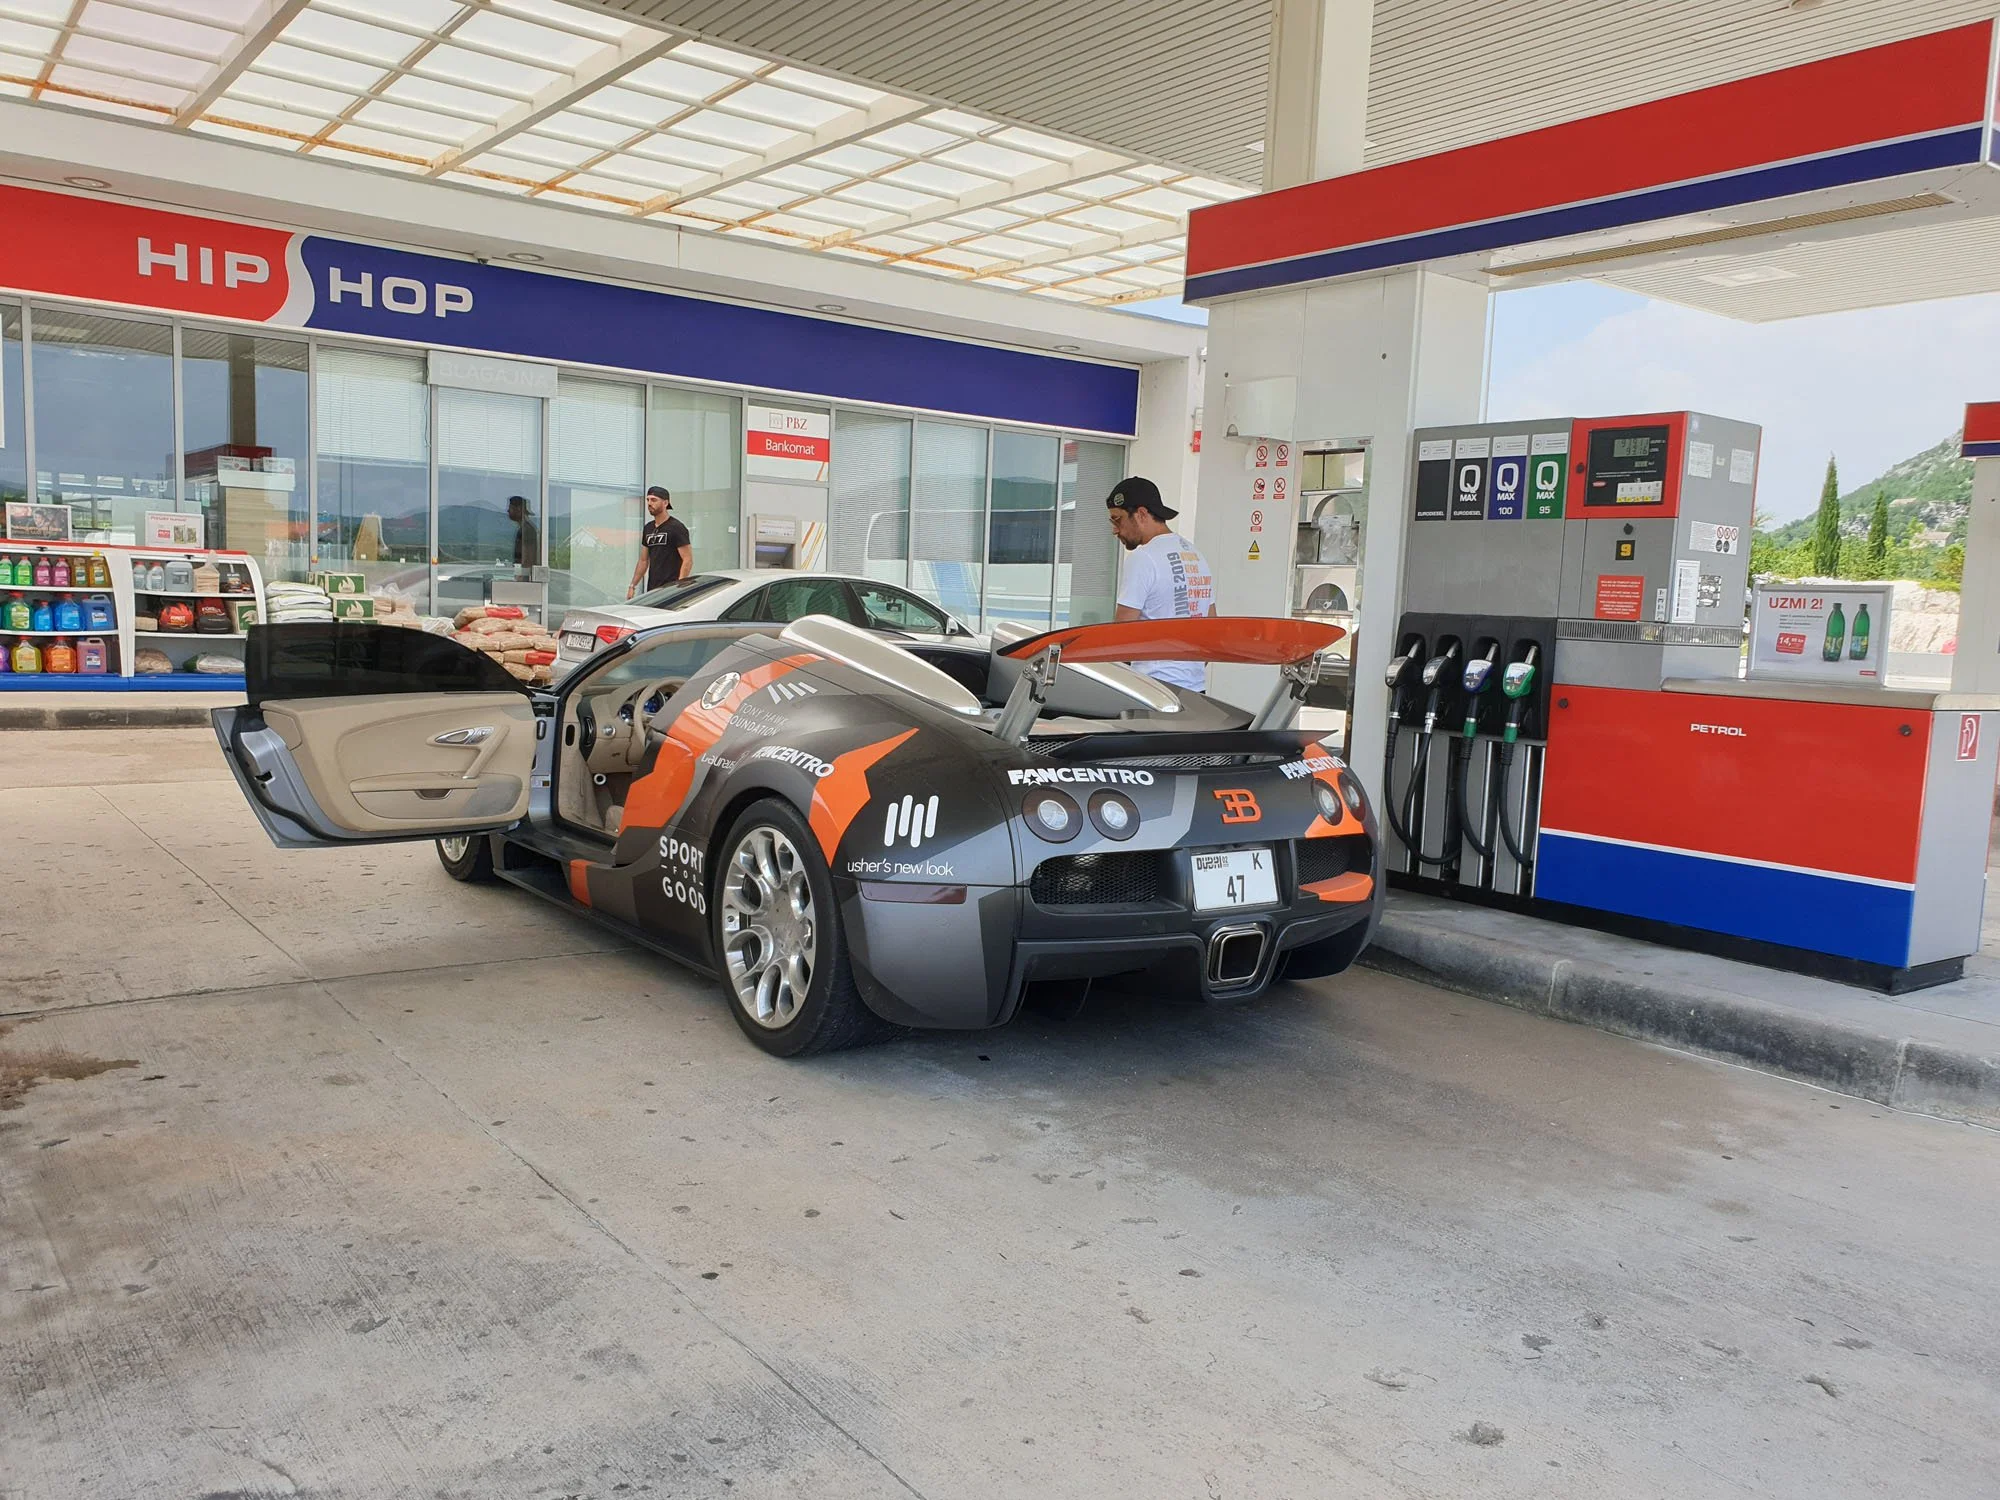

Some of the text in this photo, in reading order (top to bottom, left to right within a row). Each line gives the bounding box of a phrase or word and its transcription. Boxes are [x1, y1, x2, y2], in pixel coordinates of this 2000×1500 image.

[137, 237, 474, 318] HIP HOP
[440, 361, 550, 388] BLAGAJNA
[786, 416, 808, 430] PBZ
[765, 439, 816, 455] Bankomat
[1460, 464, 1481, 494] Q
[1496, 462, 1520, 493] Q
[1535, 461, 1559, 492] Q
[1459, 493, 1477, 502] MAX
[1496, 492, 1515, 501] MAX
[1536, 491, 1555, 500] MAX
[1498, 507, 1513, 515] 100
[1538, 506, 1551, 514] 95
[1620, 543, 1632, 556] 9
[1167, 552, 1190, 616] JUNE 2019
[1768, 597, 1824, 610] UZMI 2!
[740, 702, 764, 717] TONY
[728, 714, 779, 737] OUNDATION
[1690, 723, 1747, 737] PETROL
[1007, 767, 1154, 786] FANCENTRO
[659, 835, 704, 873] SPORT
[1252, 852, 1263, 870] K
[847, 857, 954, 876] usher's new look
[662, 876, 707, 915] GOOD
[1227, 874, 1245, 903] 47
